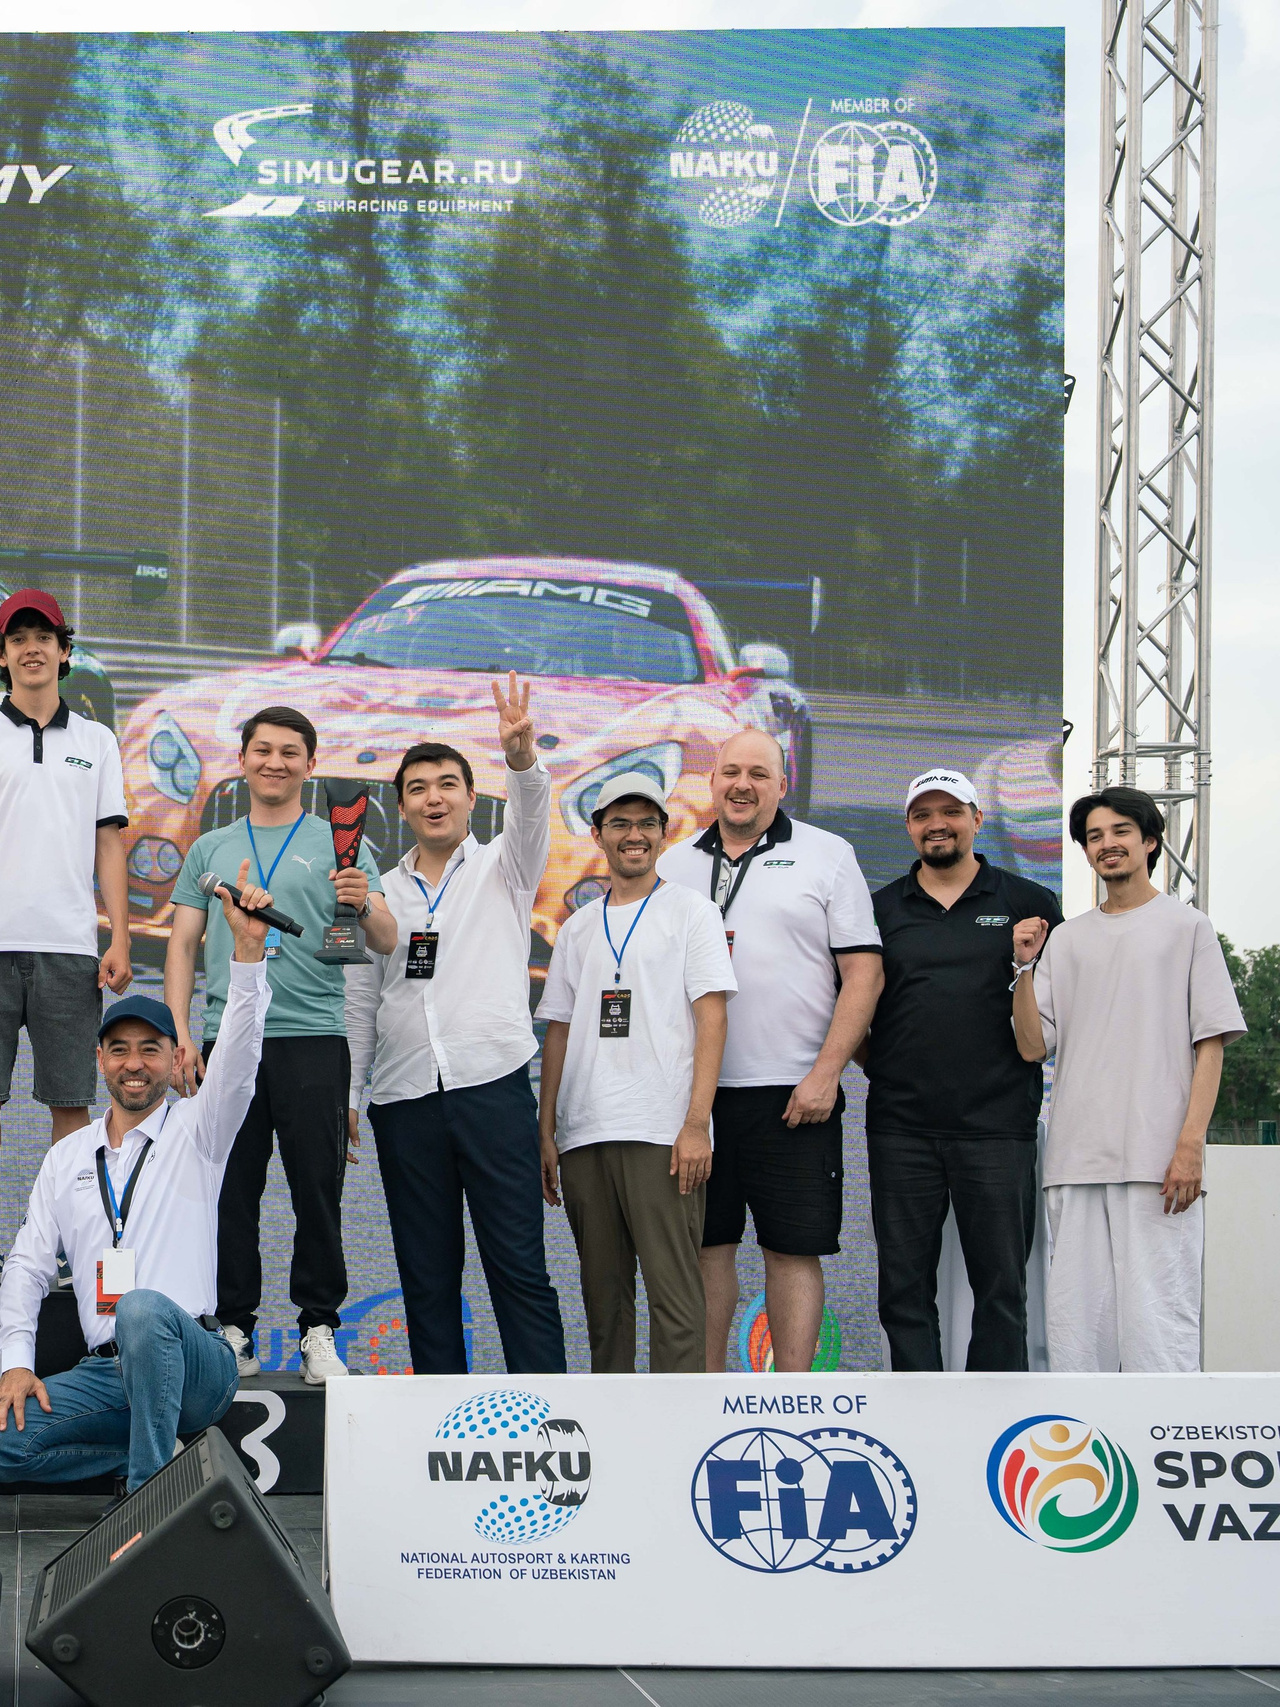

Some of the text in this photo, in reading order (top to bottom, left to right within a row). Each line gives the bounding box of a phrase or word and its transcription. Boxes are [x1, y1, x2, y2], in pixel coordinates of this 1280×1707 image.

[830, 97, 916, 113] MEMBER OF
[257, 159, 522, 185] SIMUGEAR.RU
[669, 151, 779, 178] NAFKU
[316, 200, 515, 213] SIMRACING EQUIPMENT
[722, 1394, 868, 1415] MEMBER OF
[232, 1389, 287, 1494] 3
[1150, 1425, 1280, 1441] O‘ZBEKISTO
[428, 1451, 591, 1482] NAFKU
[1153, 1450, 1280, 1490] SPO
[400, 1552, 631, 1565] NATIONAL AUTOSPORT & KARTING
[417, 1568, 616, 1580] FEDERATION OF UZBEKISTAN
